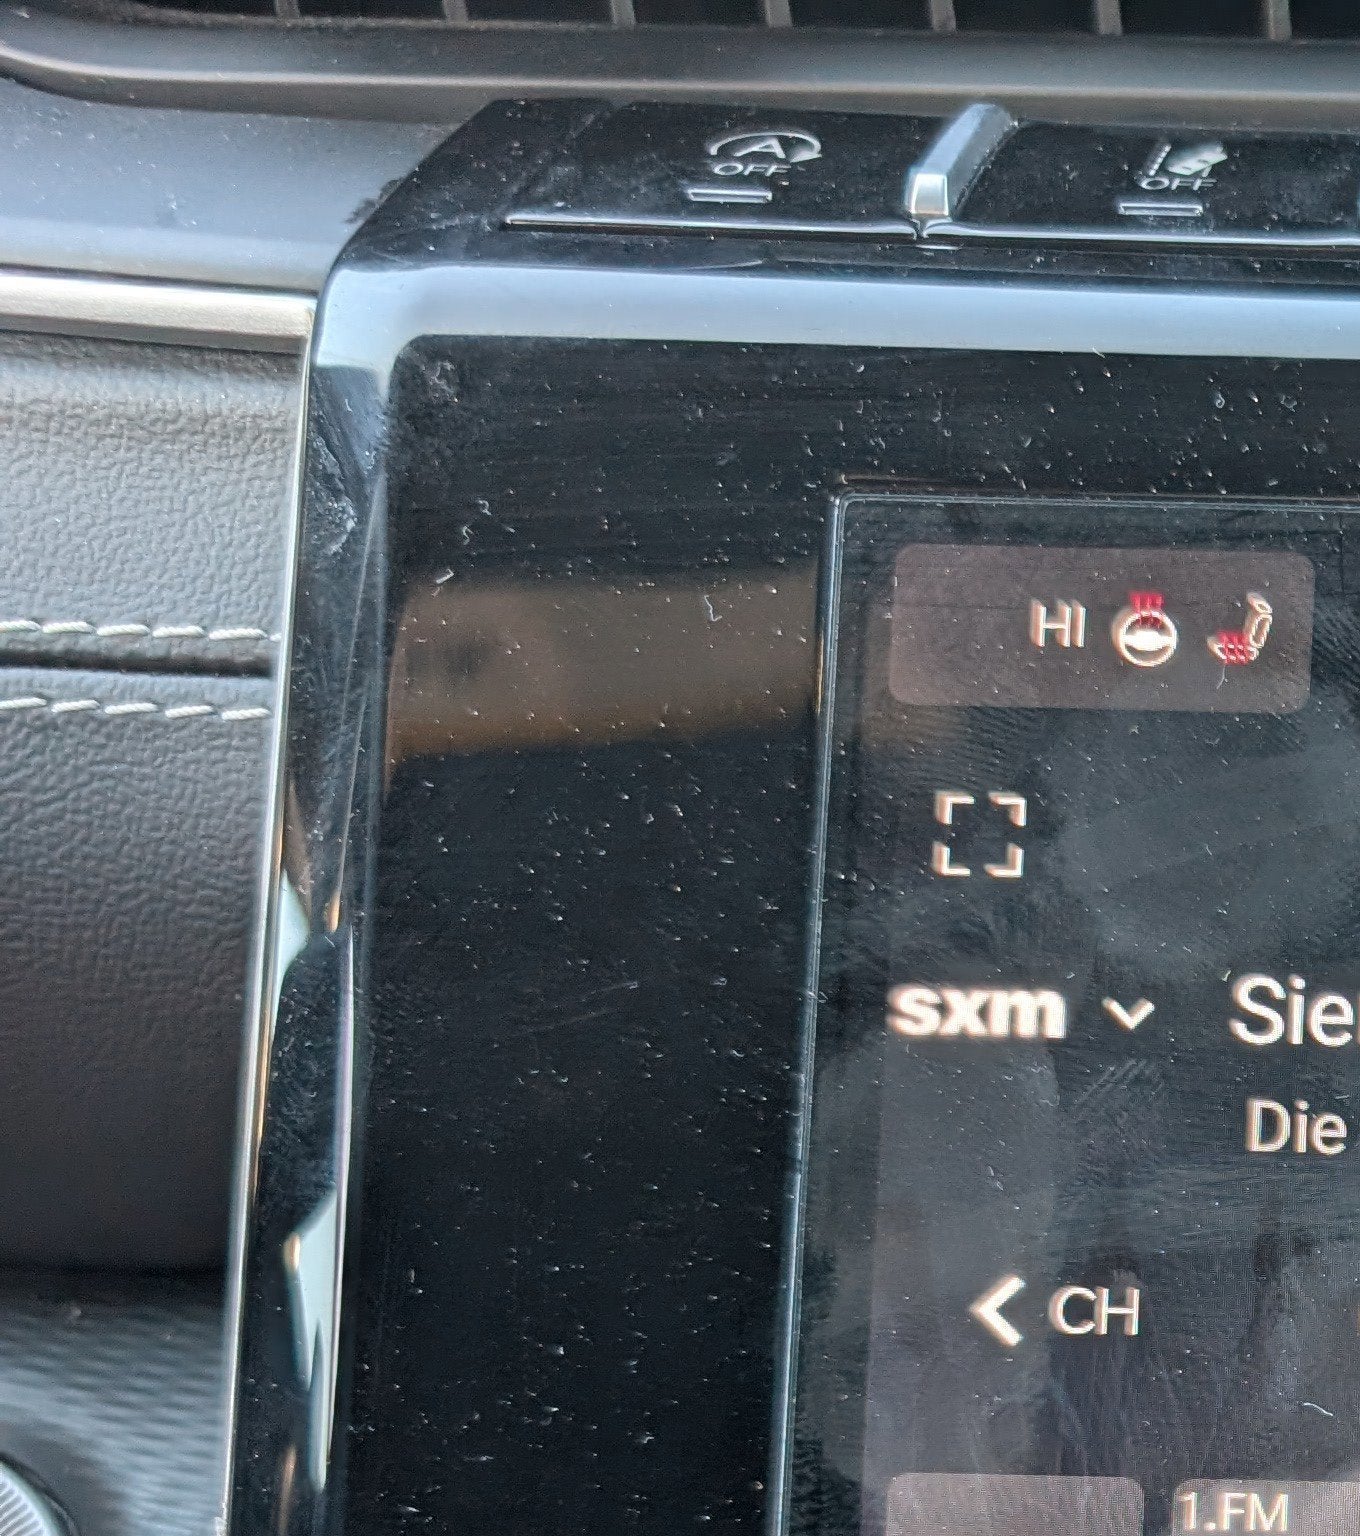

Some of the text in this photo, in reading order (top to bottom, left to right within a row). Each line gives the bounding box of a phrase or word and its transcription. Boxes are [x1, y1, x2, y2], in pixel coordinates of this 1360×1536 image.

[713, 162, 791, 177] OFF
[1140, 176, 1217, 190] OFF
[1031, 598, 1086, 648] HI
[888, 985, 1067, 1041] sxm
[1244, 1098, 1347, 1155] Die
[1048, 1286, 1142, 1338] CH
[1179, 1492, 1289, 1534] 1.FM
